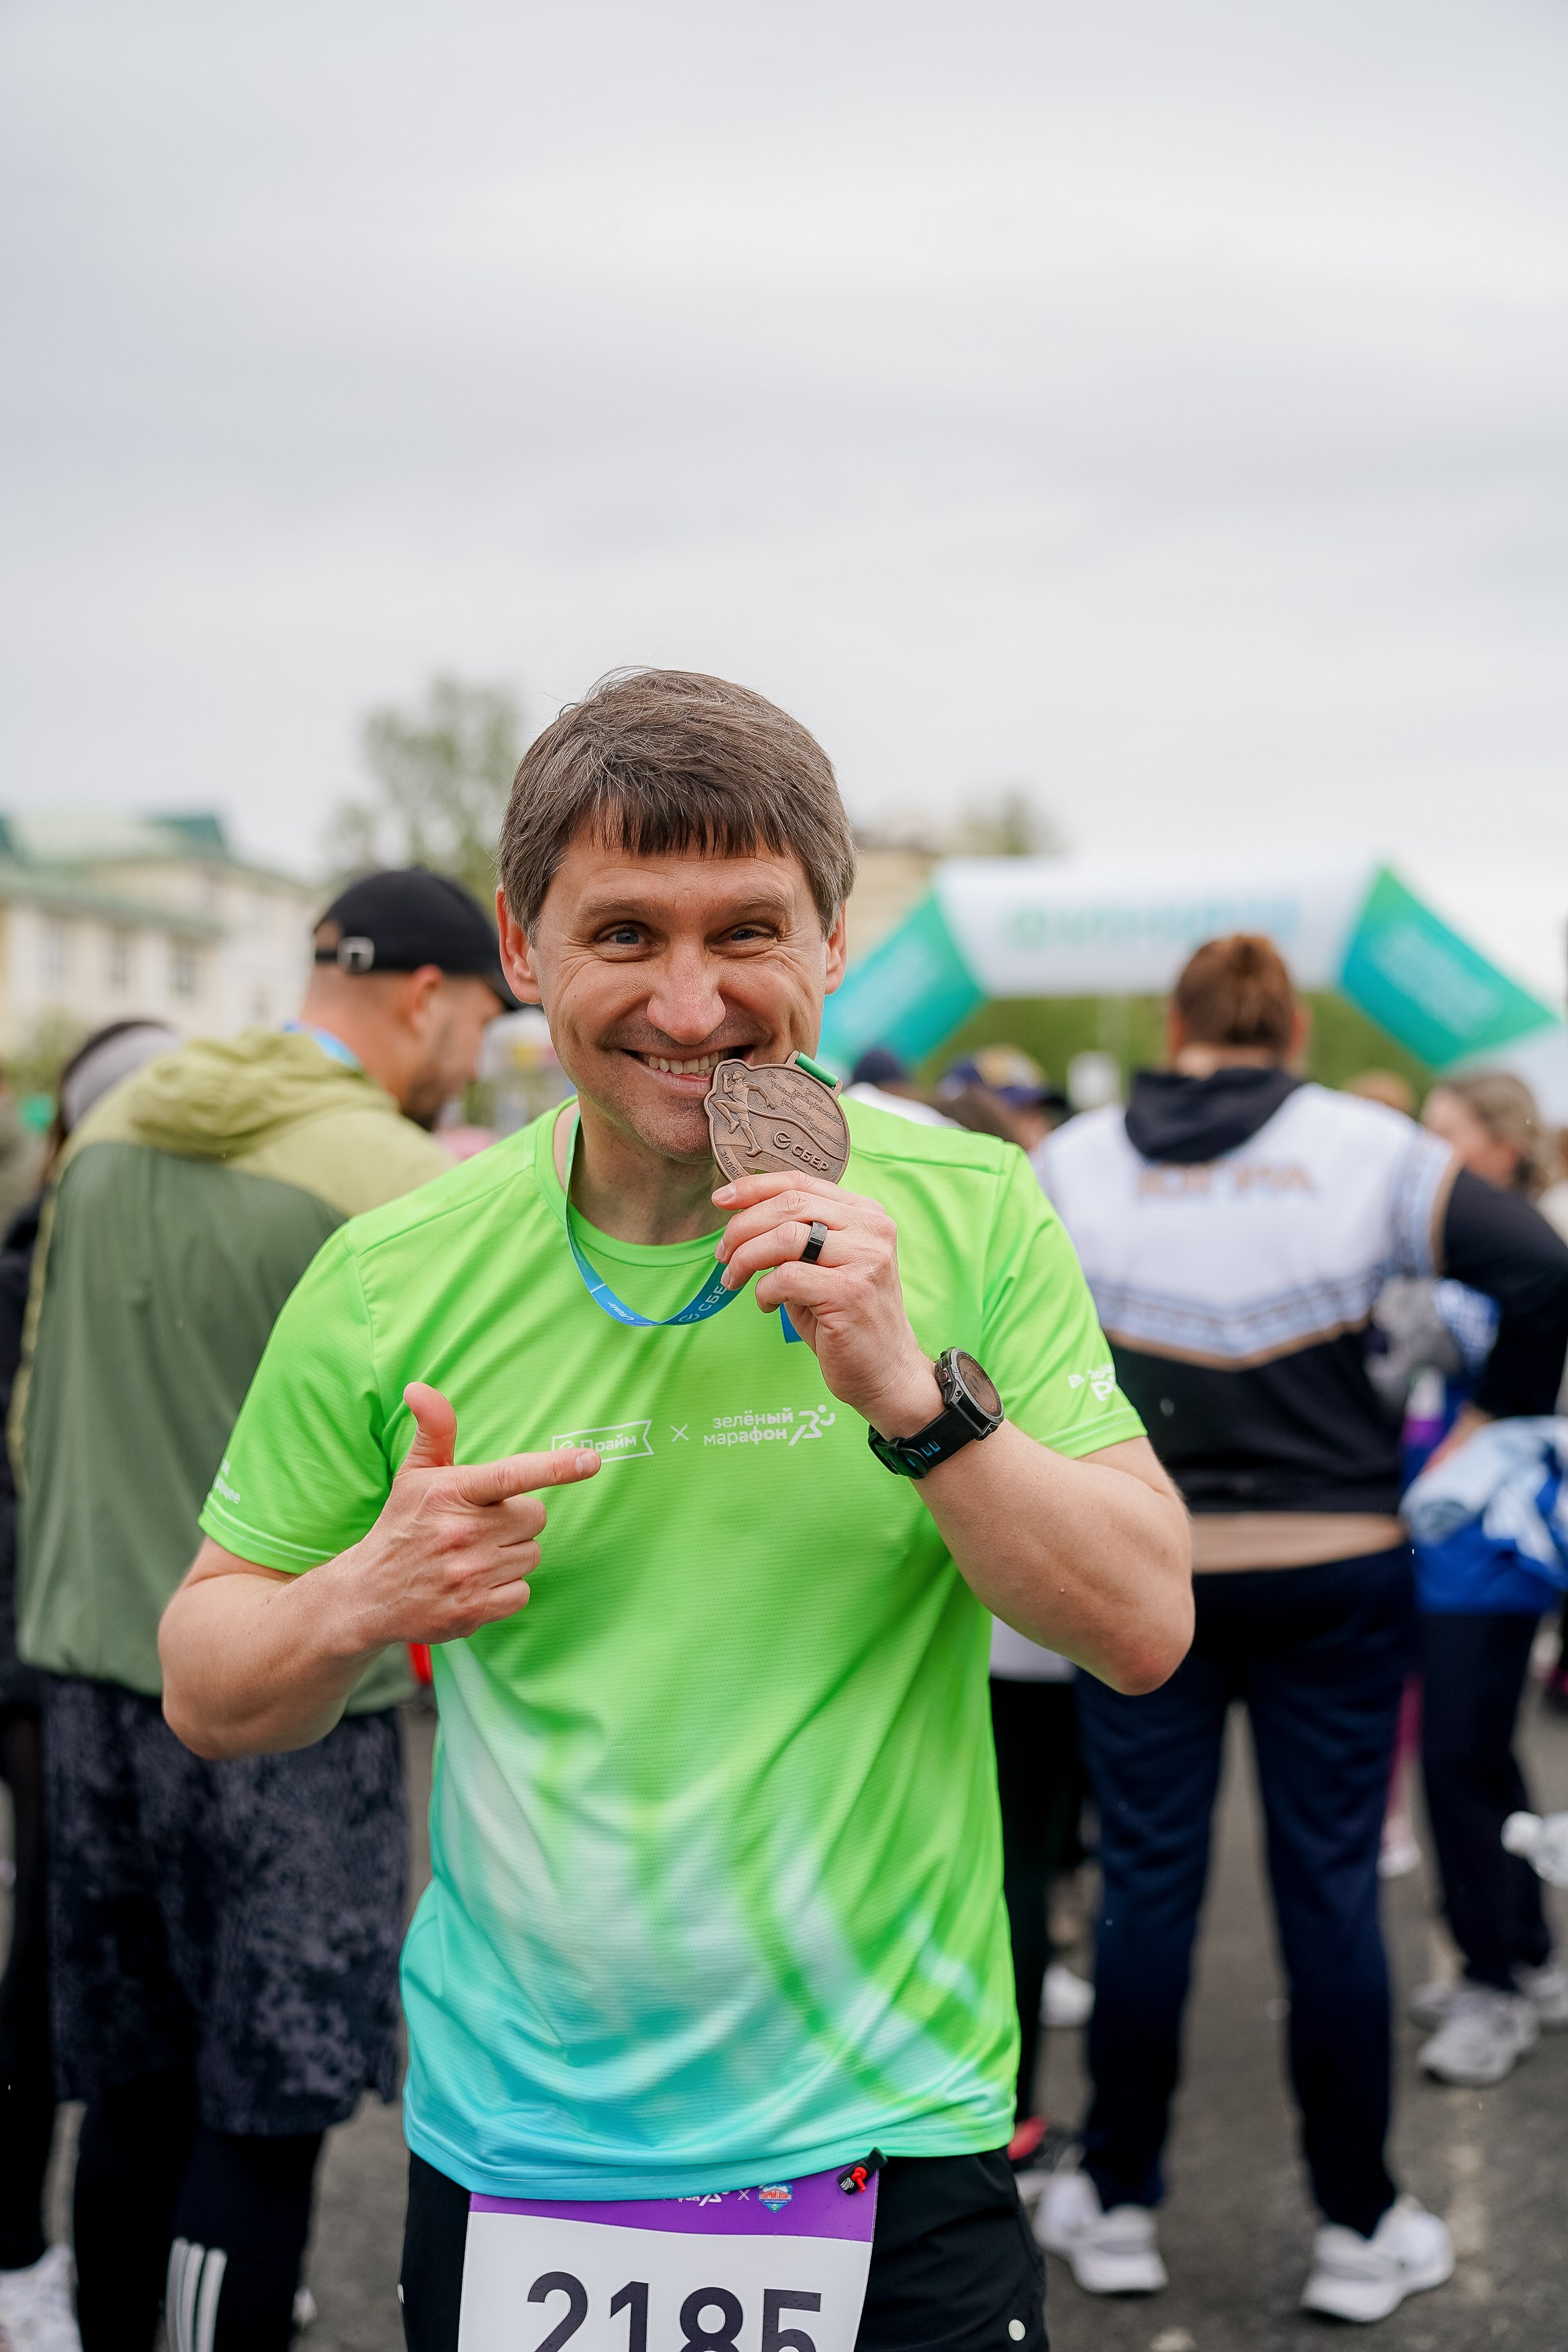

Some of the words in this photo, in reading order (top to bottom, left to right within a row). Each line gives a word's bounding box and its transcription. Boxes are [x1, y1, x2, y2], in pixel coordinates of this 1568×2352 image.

[721, 1150, 742, 1178] зелён
[791, 1144, 829, 1171] СБЕР
[699, 1286, 727, 1312] СБЕ
[713, 1406, 793, 1429] зелёный
[703, 1426, 788, 1446] марафон
[527, 2271, 822, 2352] 2185
